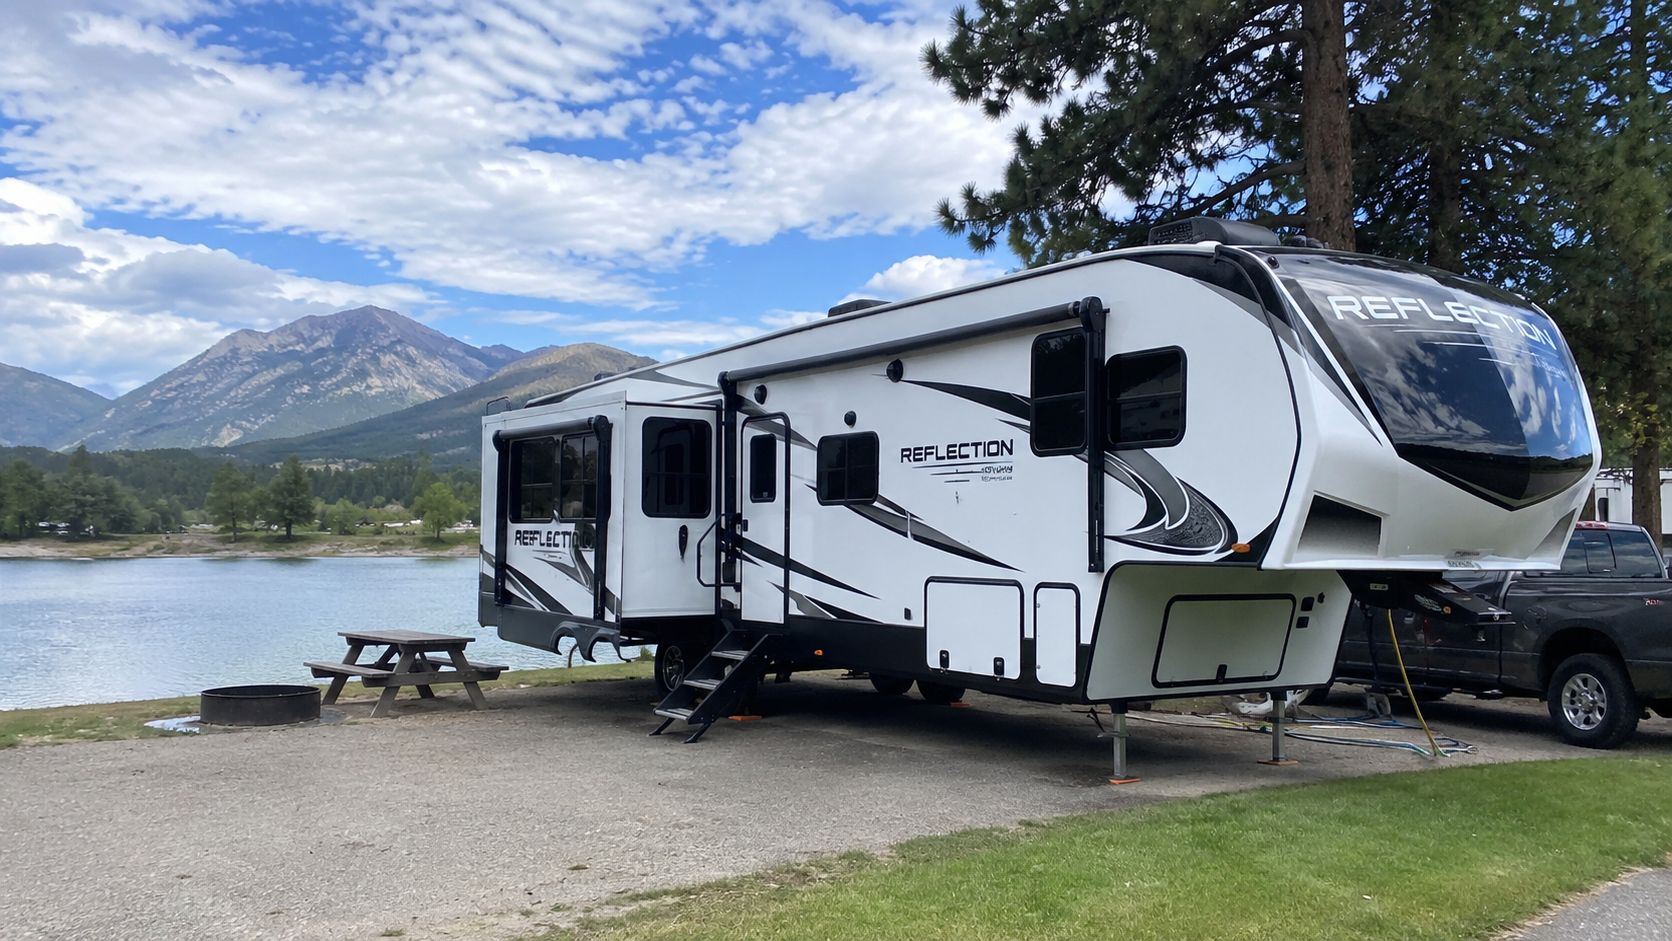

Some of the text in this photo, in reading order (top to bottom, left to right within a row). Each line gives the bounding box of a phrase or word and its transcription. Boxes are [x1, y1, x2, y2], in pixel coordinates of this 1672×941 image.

[1327, 295, 1557, 350] REFLECTION
[900, 439, 1014, 463] REFLECTION
[514, 529, 588, 549] REFLECTIO
